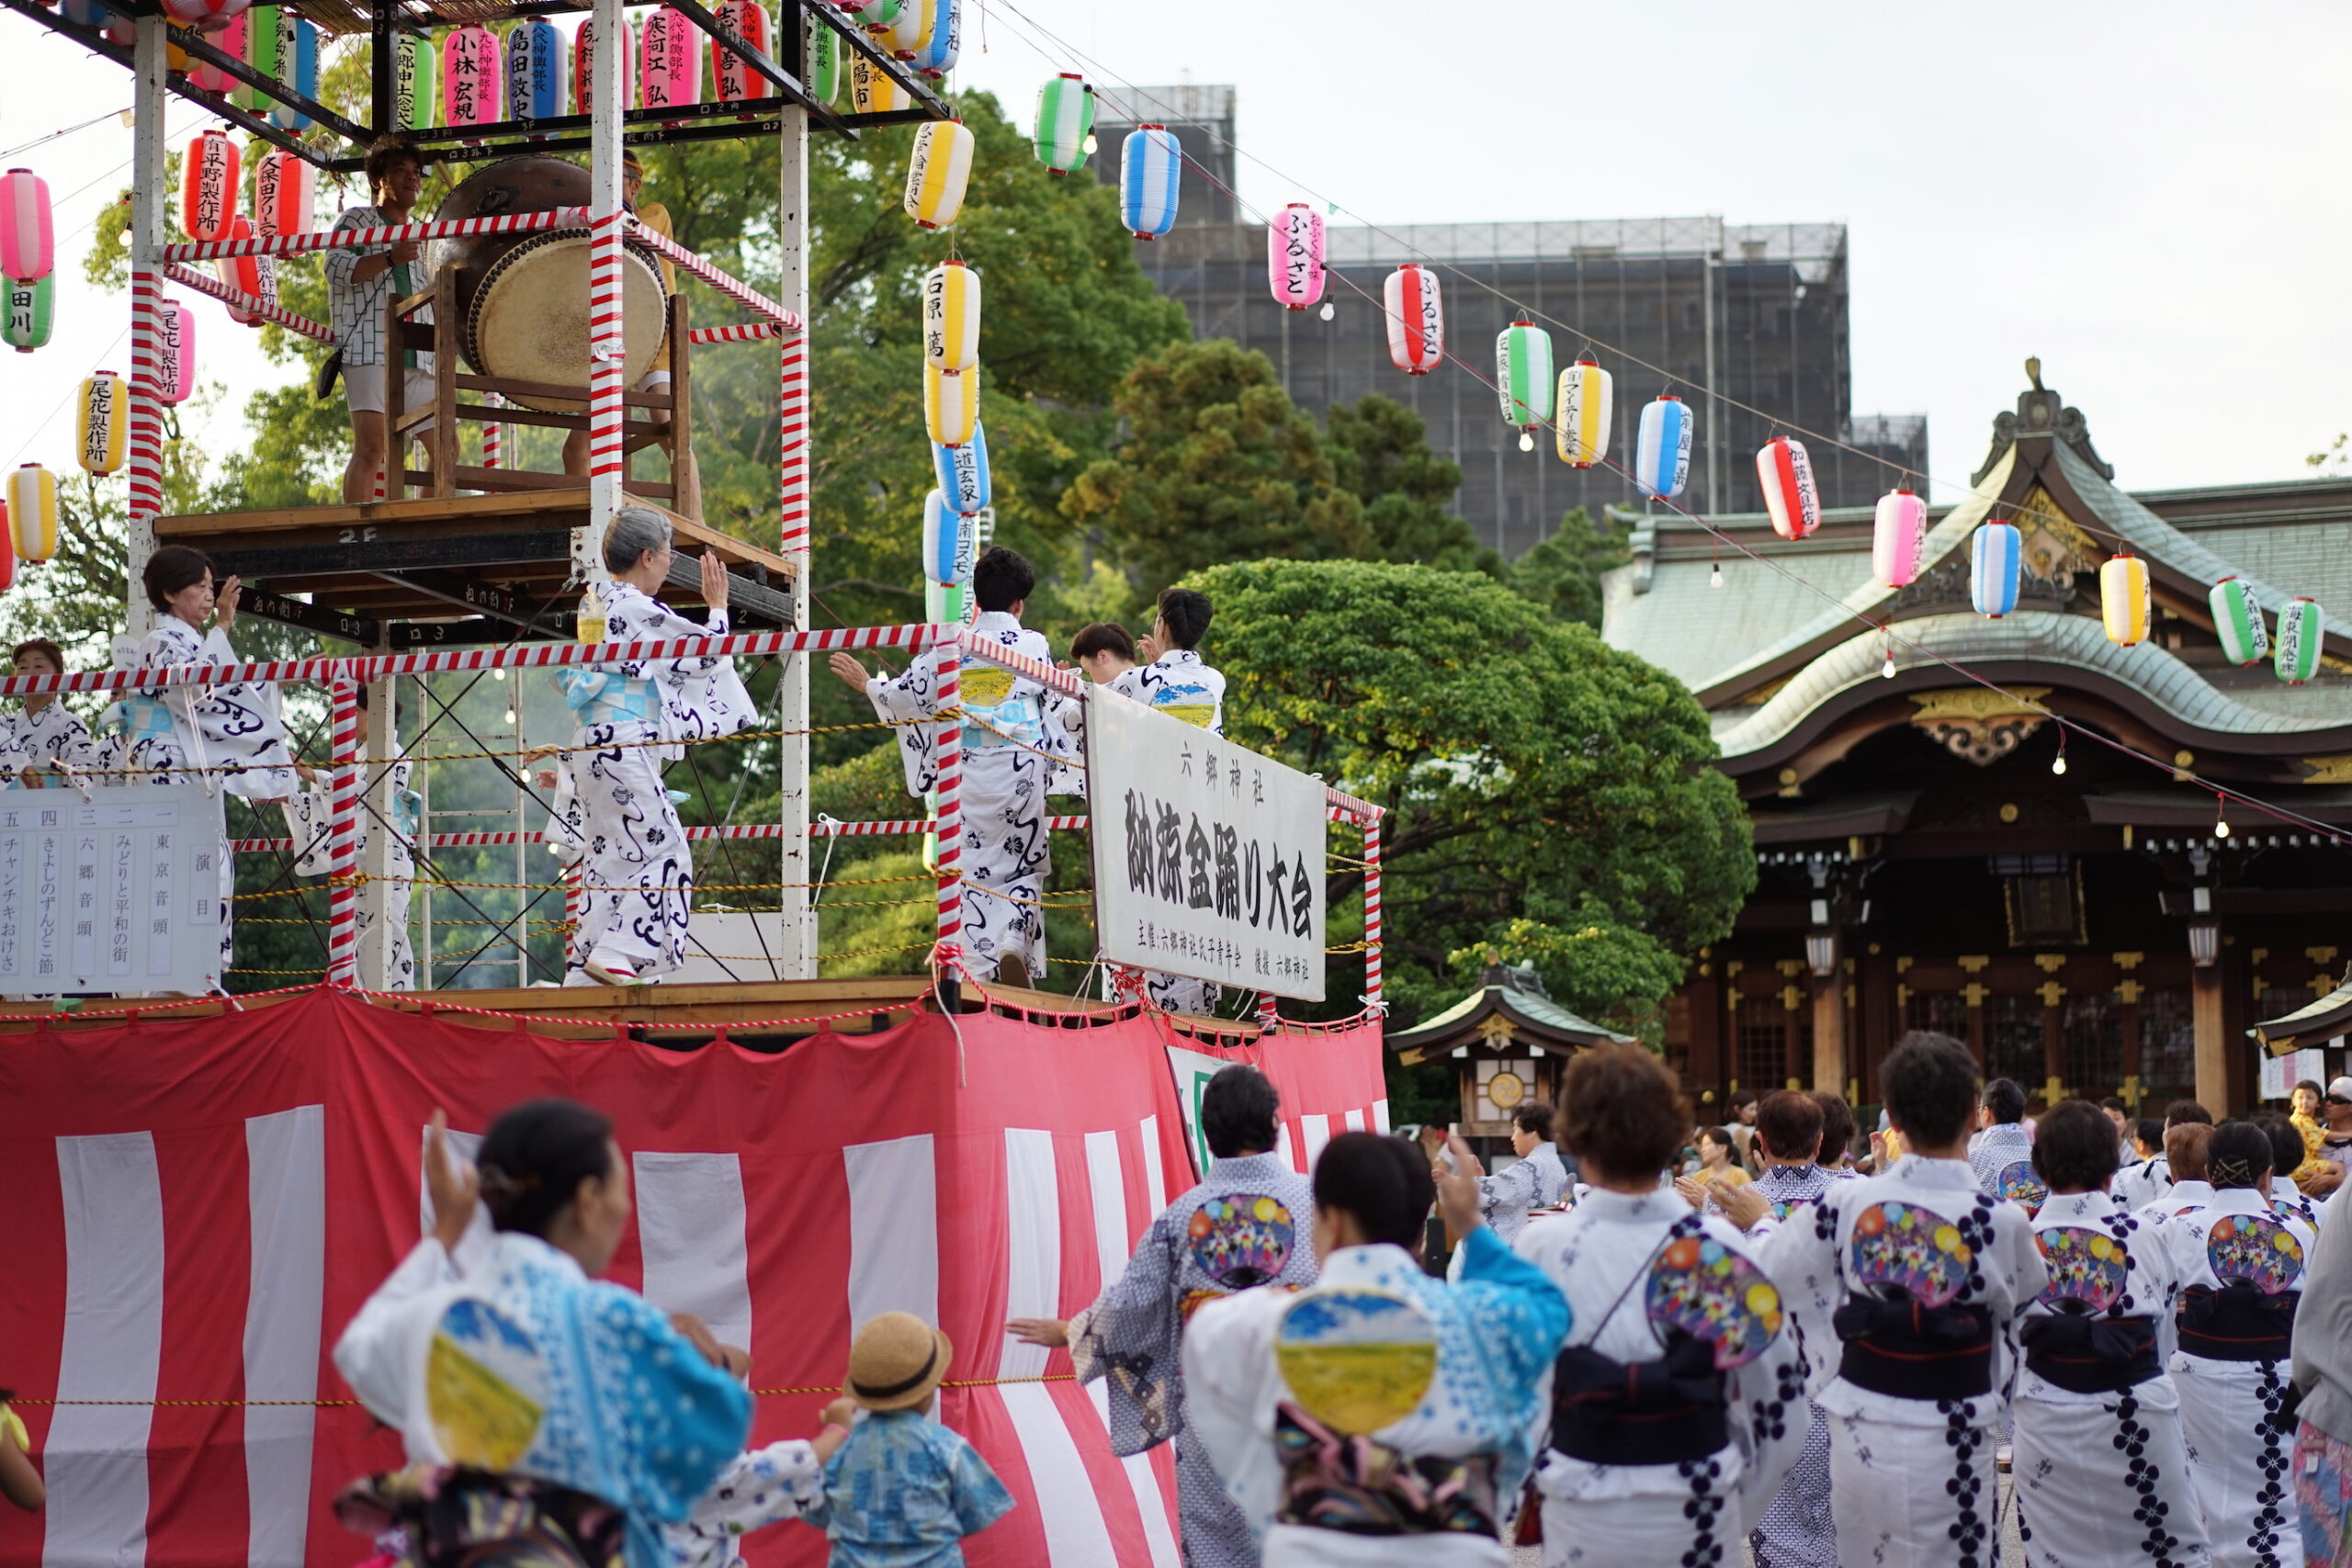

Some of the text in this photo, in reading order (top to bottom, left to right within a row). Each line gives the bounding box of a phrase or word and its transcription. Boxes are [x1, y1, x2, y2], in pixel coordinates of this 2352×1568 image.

[1284, 214, 1308, 294] ふるさと
[1419, 276, 1437, 355] ふるさと
[85, 379, 112, 463] 尾花製作所
[1788, 448, 1815, 527] 加藤文具店
[338, 525, 379, 544] 2F
[2242, 582, 2267, 658] 大森米店
[1180, 740, 1265, 806] 六郷神社
[0, 810, 20, 972] 五 チャンチキおけさ
[38, 808, 58, 975] 四 きよしのずんどこ節
[76, 808, 96, 937] 三 六郷音頭
[112, 807, 134, 964] 二 みどりと平和の街
[153, 832, 171, 934] 東京音頭
[195, 852, 211, 917] 演目
[1124, 787, 1313, 942] 納涼盆踊り大会
